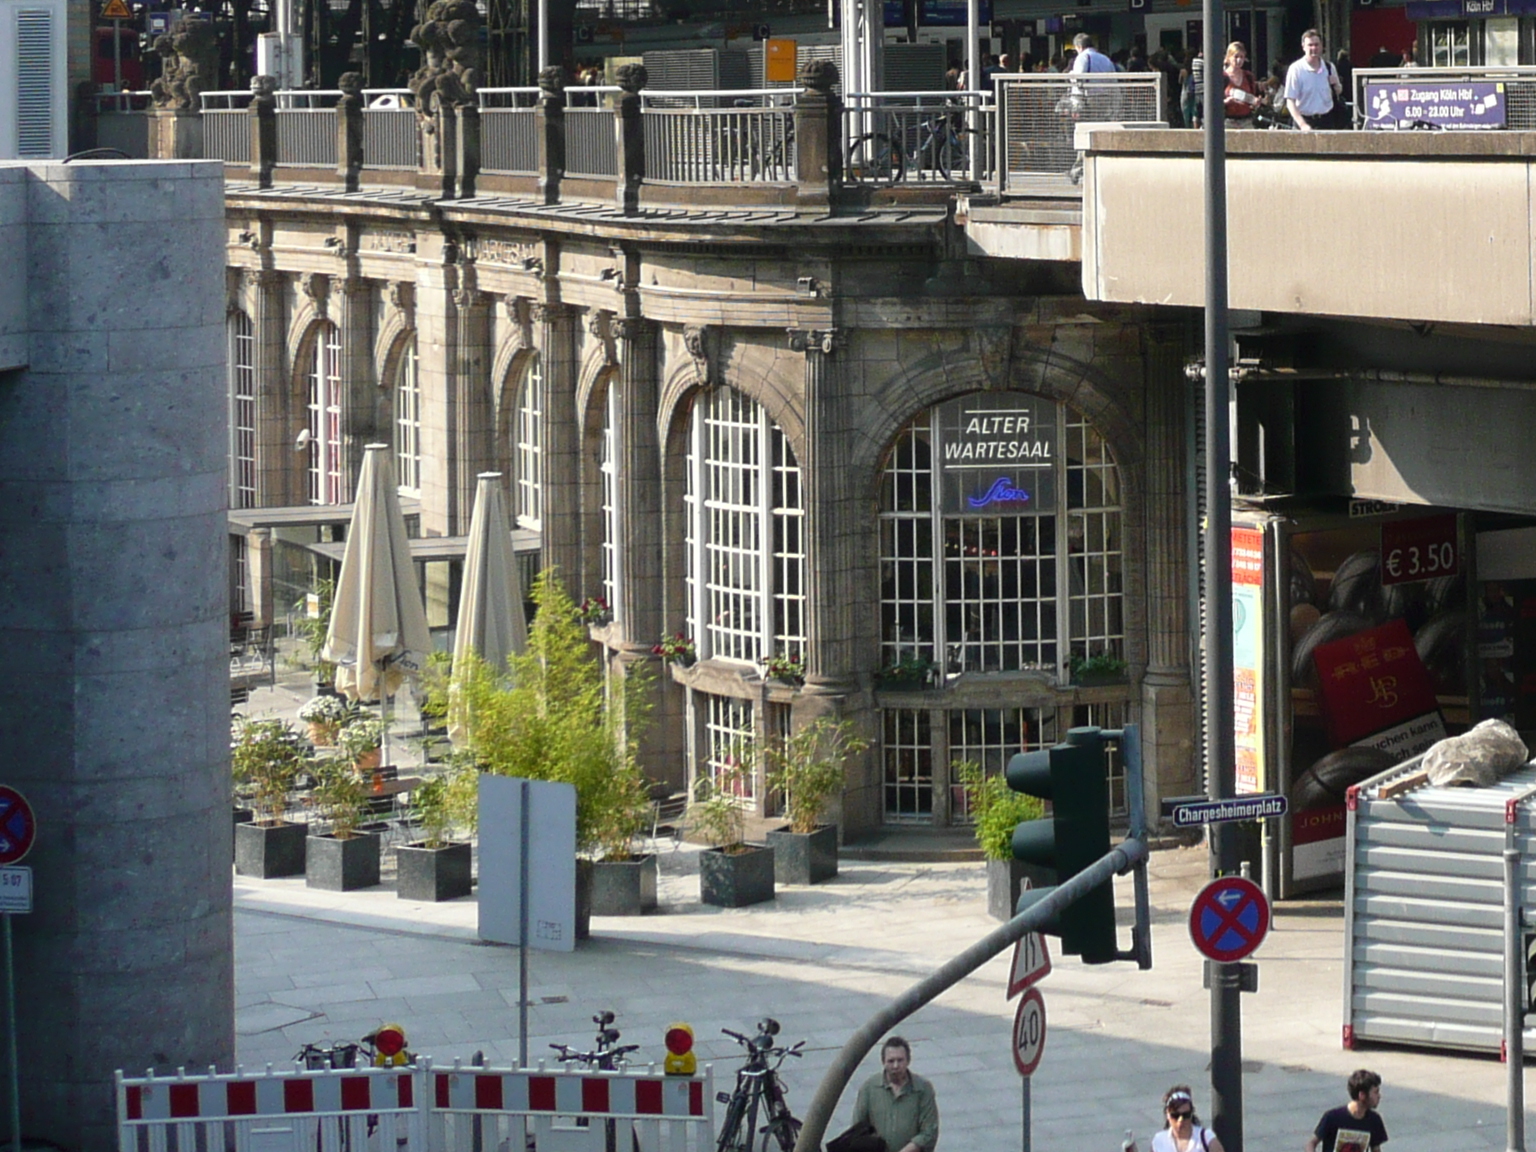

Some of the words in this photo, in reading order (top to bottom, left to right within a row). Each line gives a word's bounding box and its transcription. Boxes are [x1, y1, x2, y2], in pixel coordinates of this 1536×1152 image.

[1466, 0, 1482, 13] Köln
[1482, 0, 1495, 12] Hbf
[578, 25, 590, 41] C
[758, 24, 769, 38] C
[1410, 89, 1439, 103] Zugang
[1440, 88, 1457, 101] Köln
[1458, 88, 1472, 101] Hbf
[1405, 106, 1422, 118] 6.00
[1450, 104, 1465, 118] Uhr
[965, 416, 1030, 434] ALTER
[945, 441, 1051, 459] WARTESAAL
[1385, 549, 1402, 577] €
[1408, 541, 1454, 575] 3.50
[1372, 730, 1409, 750] uchen
[1409, 719, 1438, 736] kann
[1178, 800, 1281, 823] Chargesheimerplatz
[1018, 1009, 1039, 1051] 40
